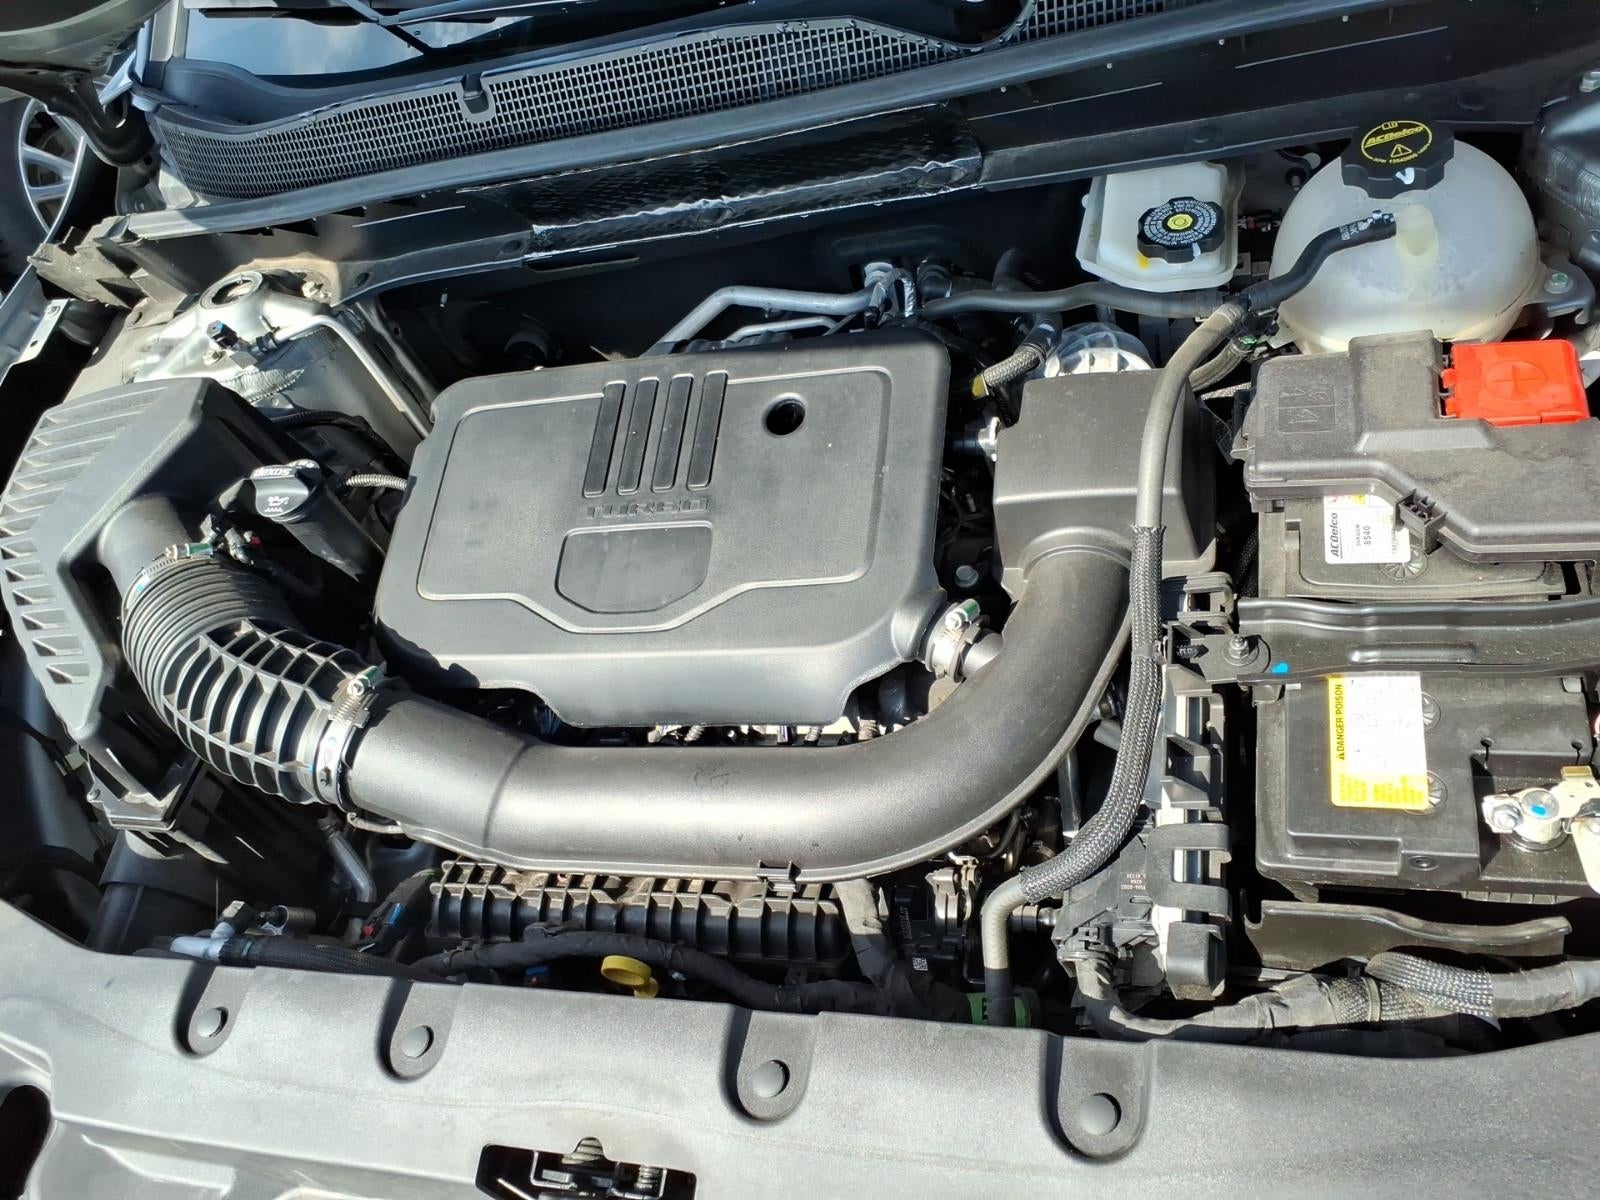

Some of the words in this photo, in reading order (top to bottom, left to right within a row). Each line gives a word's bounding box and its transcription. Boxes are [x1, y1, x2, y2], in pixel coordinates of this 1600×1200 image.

[1330, 512, 1340, 557] ACDelco
[1335, 684, 1344, 715] POISON
[1336, 717, 1345, 752] DANGER
